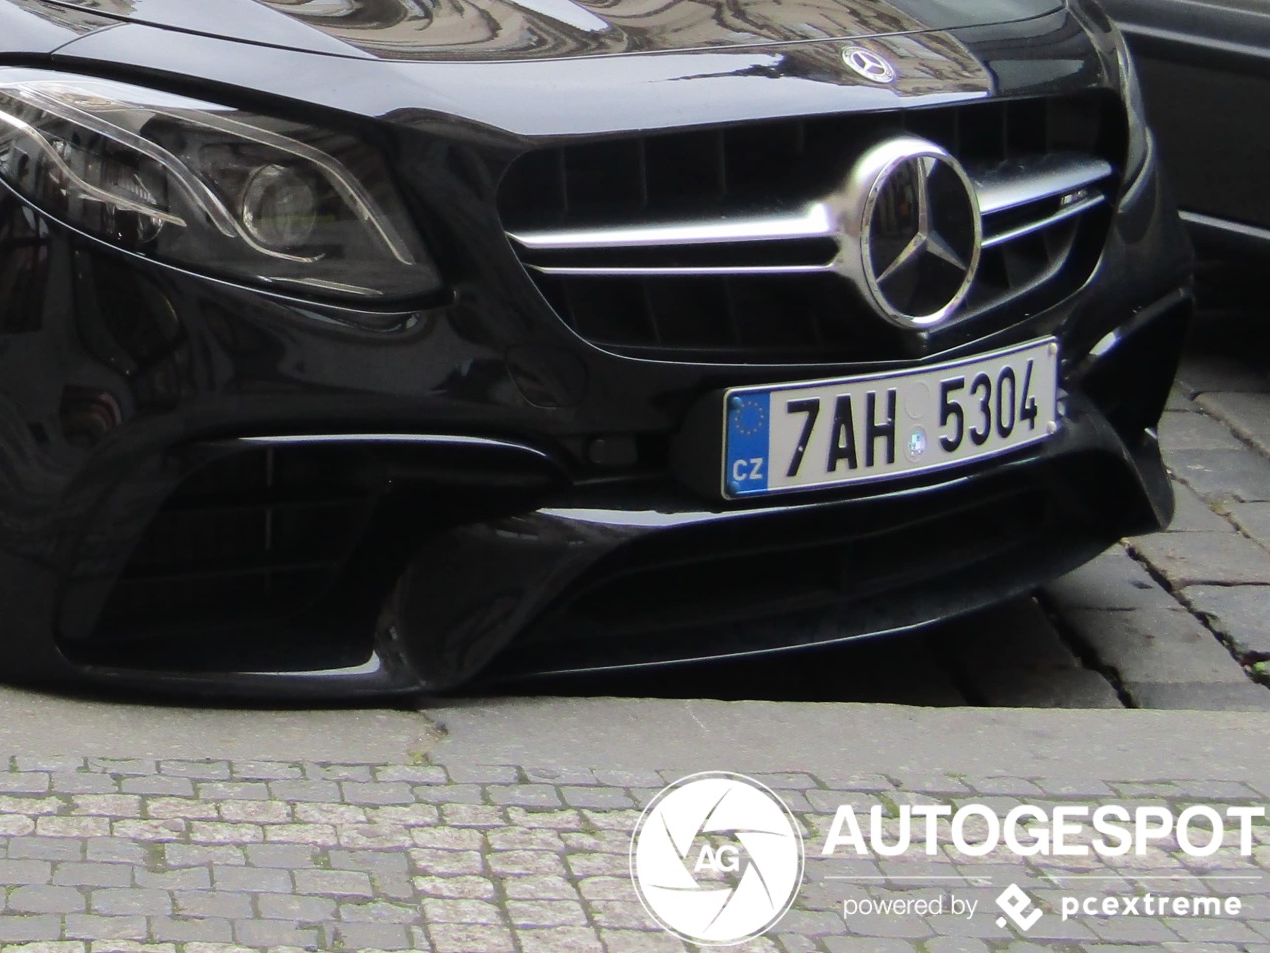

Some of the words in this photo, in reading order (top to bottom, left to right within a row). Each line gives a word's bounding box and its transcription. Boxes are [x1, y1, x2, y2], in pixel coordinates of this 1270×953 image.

[786, 388, 897, 478] 7AH
[938, 359, 1038, 453] 5304
[732, 457, 763, 481] CZ
